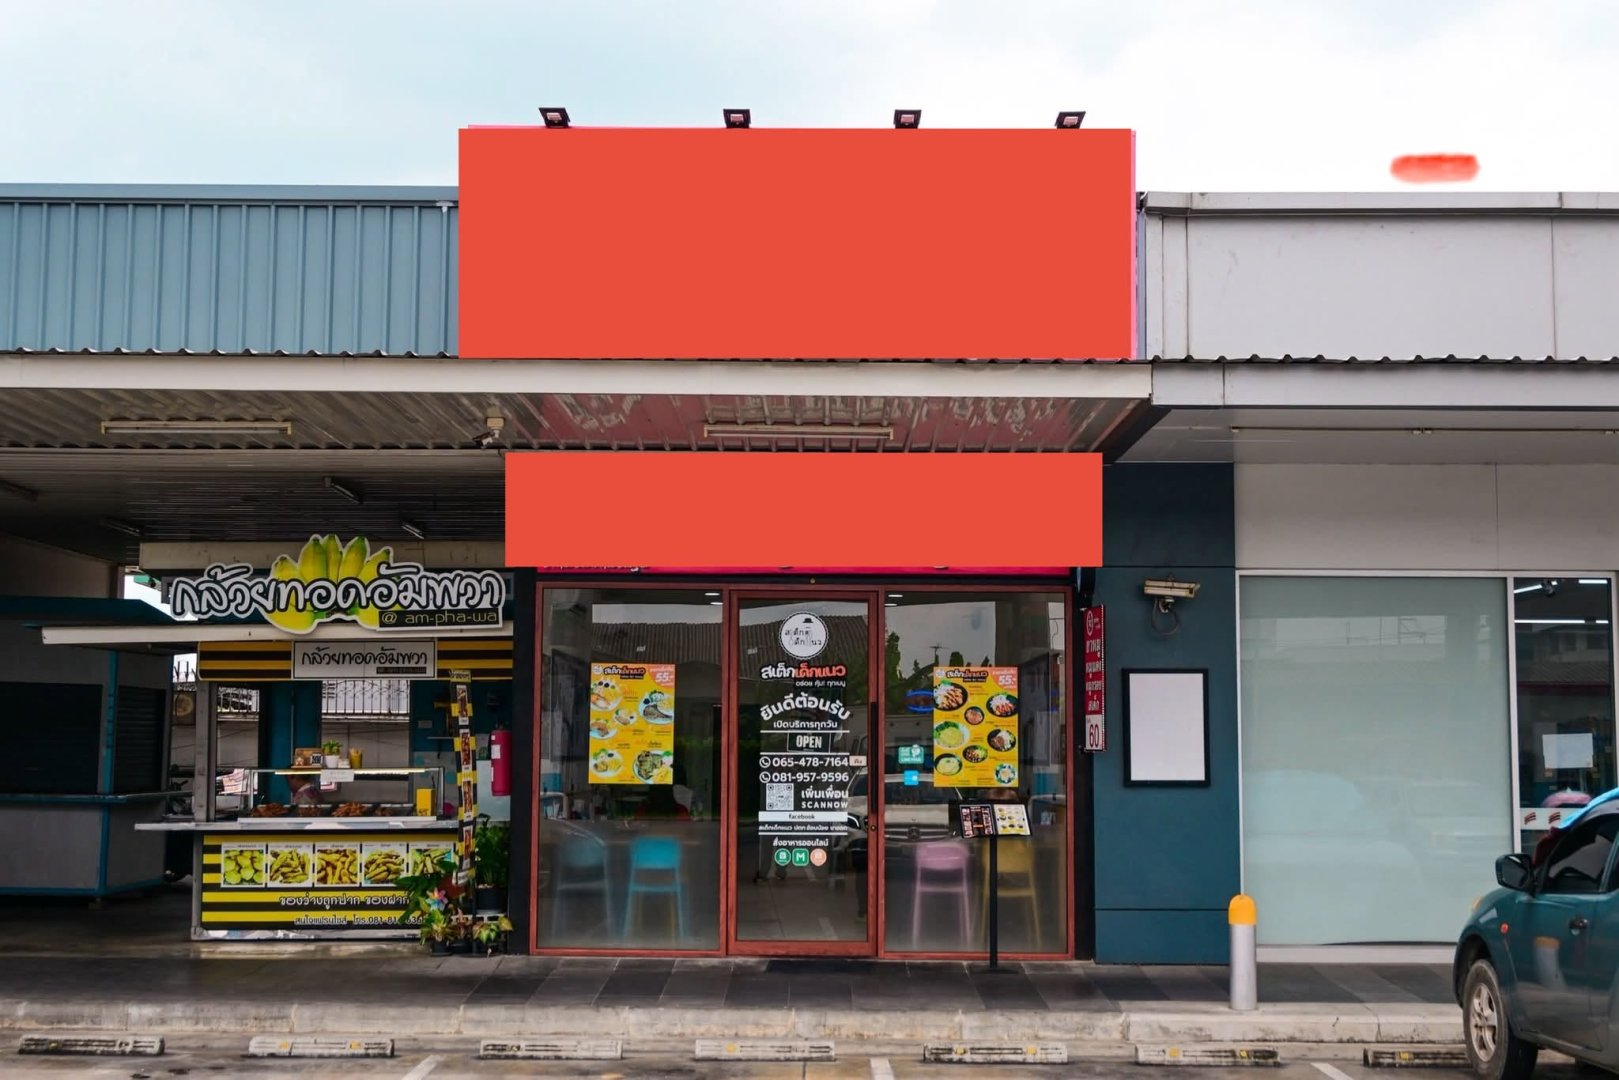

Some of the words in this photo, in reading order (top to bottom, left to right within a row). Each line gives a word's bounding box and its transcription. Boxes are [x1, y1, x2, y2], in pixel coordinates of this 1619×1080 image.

[172, 562, 502, 616] กล้วยทอดอัมพวา
[405, 611, 498, 627] am-pha-wa
[301, 646, 428, 665] กล้วยทอดอัมพวา
[760, 662, 847, 680] สเต็กเด็กแนว
[760, 692, 851, 721] ยินดีต้อนรับ
[773, 720, 838, 731] เปิดบริการทุกวัน
[796, 735, 822, 749] OPEN
[1089, 724, 1100, 748] 60
[772, 757, 849, 767] 065-478-7164
[772, 773, 849, 782] 081-957-9596
[801, 784, 849, 799] เพิ่มเพื่อน
[773, 836, 829, 847] สั่งอาหารออนไลน์
[279, 892, 360, 910] ของว่างถูกปาก
